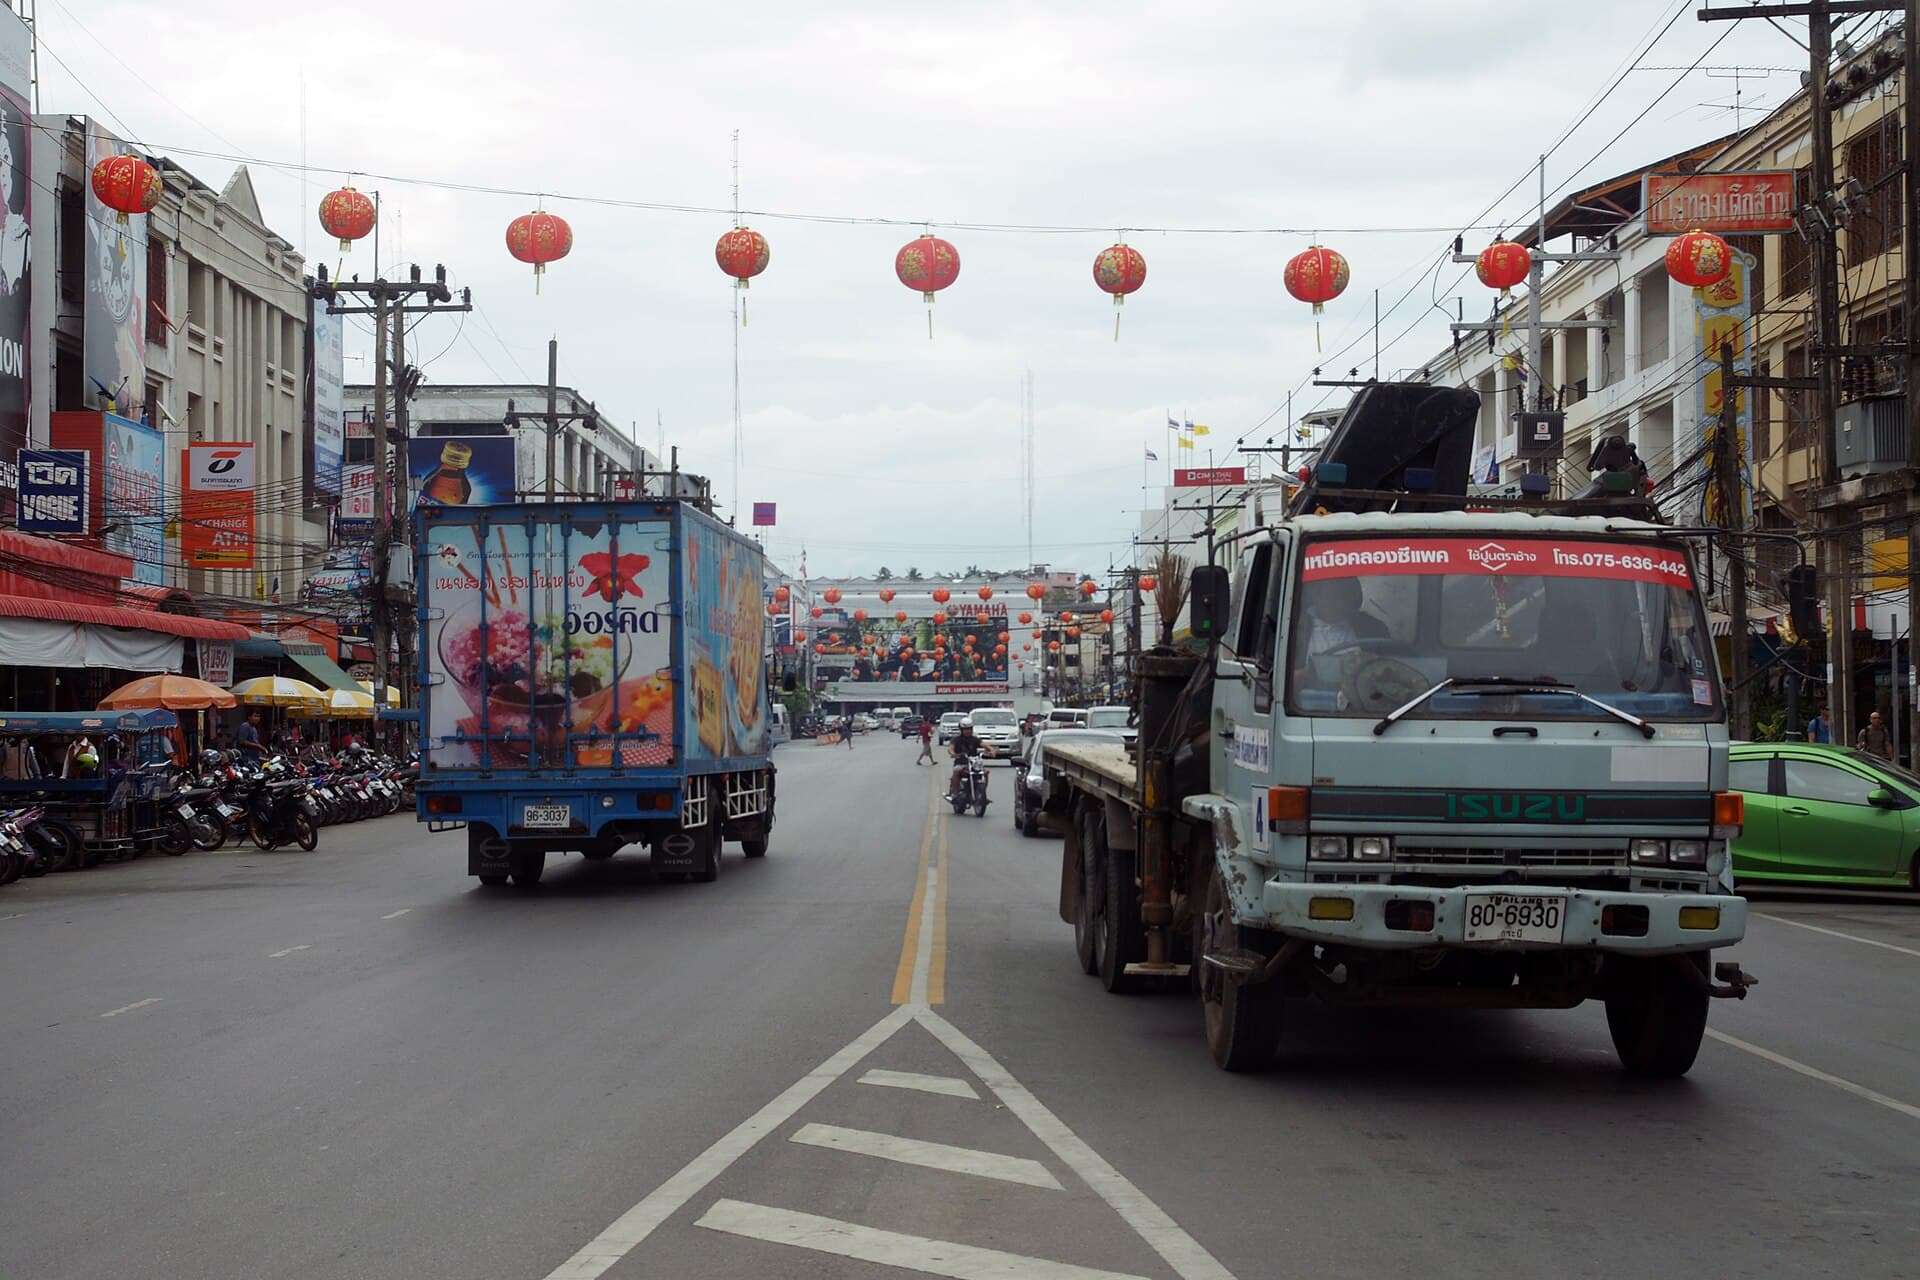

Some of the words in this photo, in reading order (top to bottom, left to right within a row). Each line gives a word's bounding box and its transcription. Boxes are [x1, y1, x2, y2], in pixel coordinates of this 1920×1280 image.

[22, 494, 79, 522] VOGUE
[211, 530, 249, 547] ATM
[1304, 545, 1449, 571] เหนือคลองซีแพค
[1552, 547, 1688, 578] โทร.075-636-442
[959, 603, 1008, 617] YAMAHA
[526, 810, 568, 822] 96-3037
[1447, 794, 1585, 821] ISUZU
[664, 858, 693, 866] HINO
[1488, 896, 1543, 905] THAILAND
[1470, 904, 1559, 929] 80-6930
